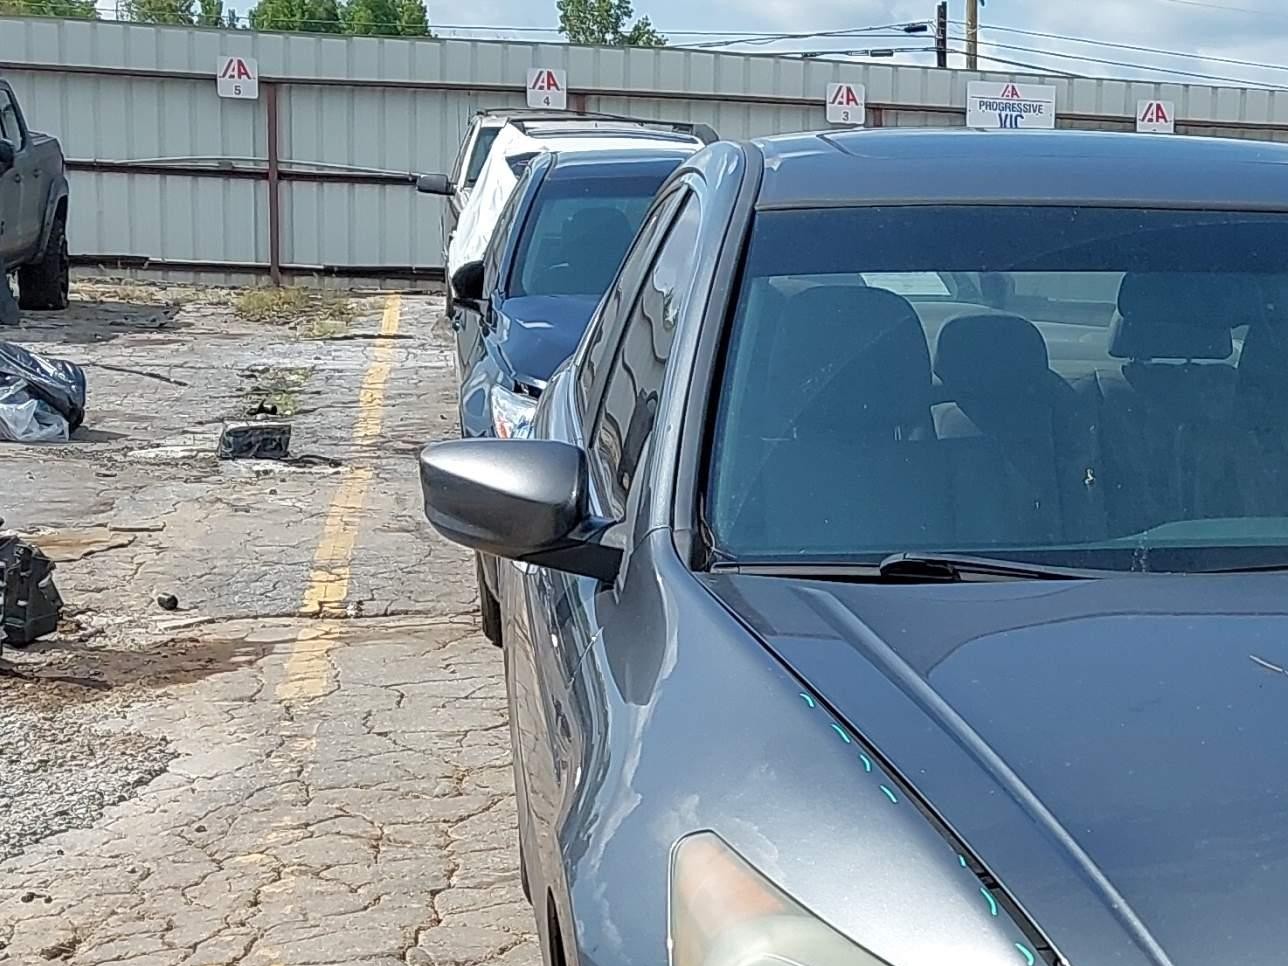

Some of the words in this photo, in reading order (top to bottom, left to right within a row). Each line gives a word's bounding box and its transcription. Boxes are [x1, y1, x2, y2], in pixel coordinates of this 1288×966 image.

[234, 85, 242, 96] 5
[543, 96, 551, 106] 4
[979, 101, 1044, 114] PROGRESSIVE
[842, 111, 850, 122] 3
